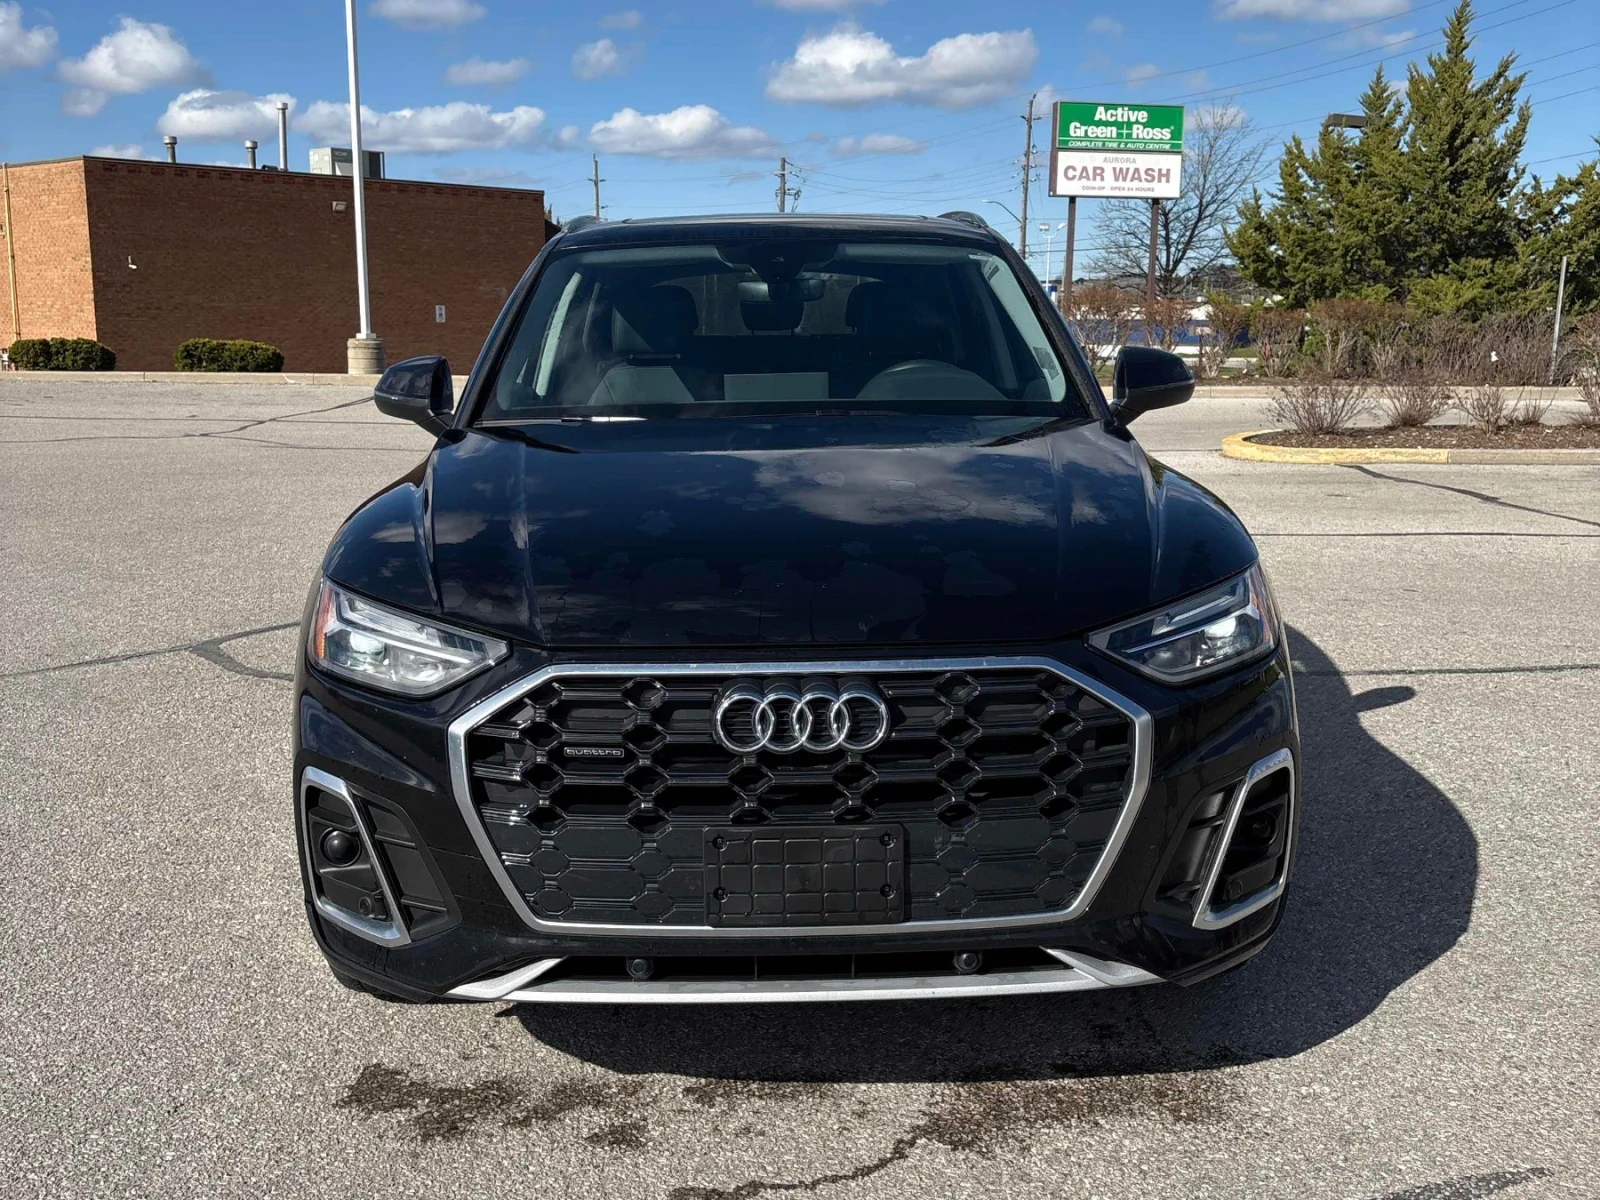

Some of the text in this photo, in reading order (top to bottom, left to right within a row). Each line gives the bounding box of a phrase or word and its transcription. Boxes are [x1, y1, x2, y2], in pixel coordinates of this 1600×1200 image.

[1094, 106, 1148, 122] Active
[1103, 156, 1137, 164] AURORA
[1063, 165, 1171, 184] CAR WASH
[566, 748, 621, 756] quattro
